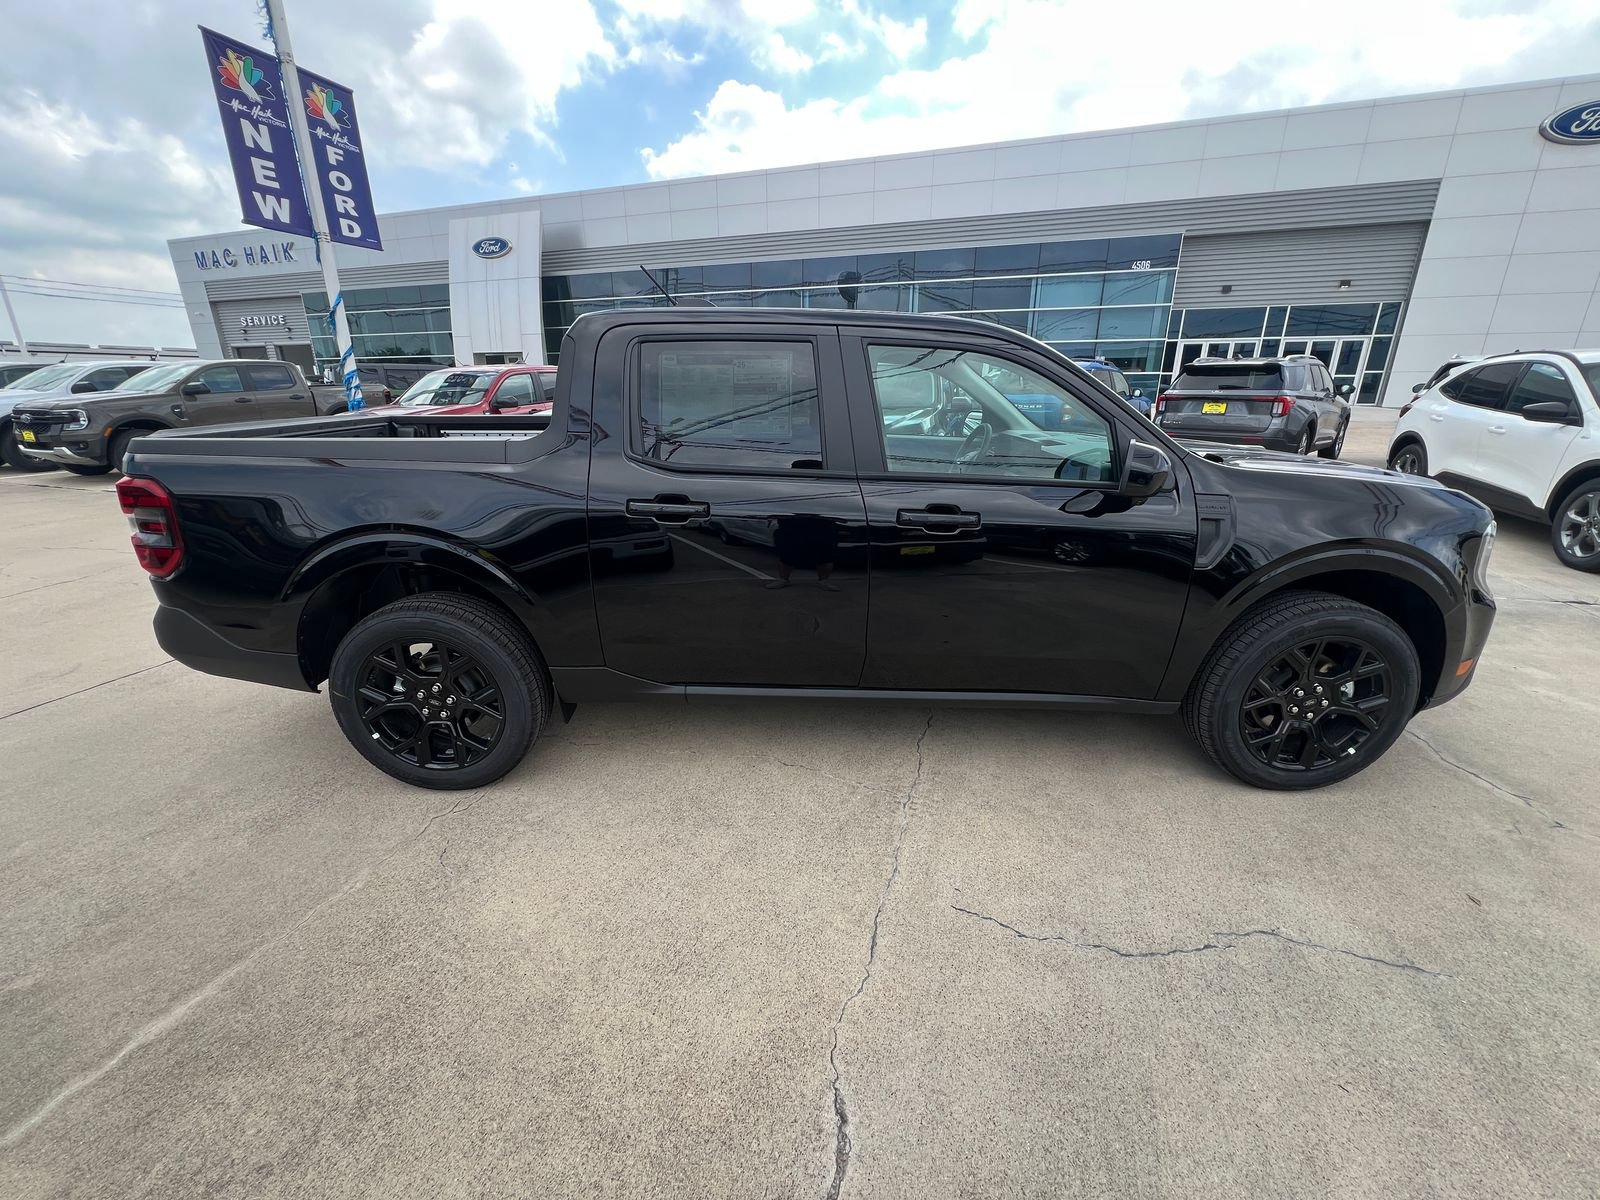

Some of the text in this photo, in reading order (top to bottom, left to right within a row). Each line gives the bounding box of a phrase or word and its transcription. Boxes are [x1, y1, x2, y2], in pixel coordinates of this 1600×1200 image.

[226, 98, 277, 119] Mac Haik
[313, 126, 333, 140] Mac
[240, 118, 290, 224] NEW
[326, 144, 362, 239] FORD
[479, 240, 501, 253] Ford
[194, 242, 295, 270] MAC HAIK
[1132, 260, 1151, 270] 4506
[240, 315, 285, 326] SERVICE
